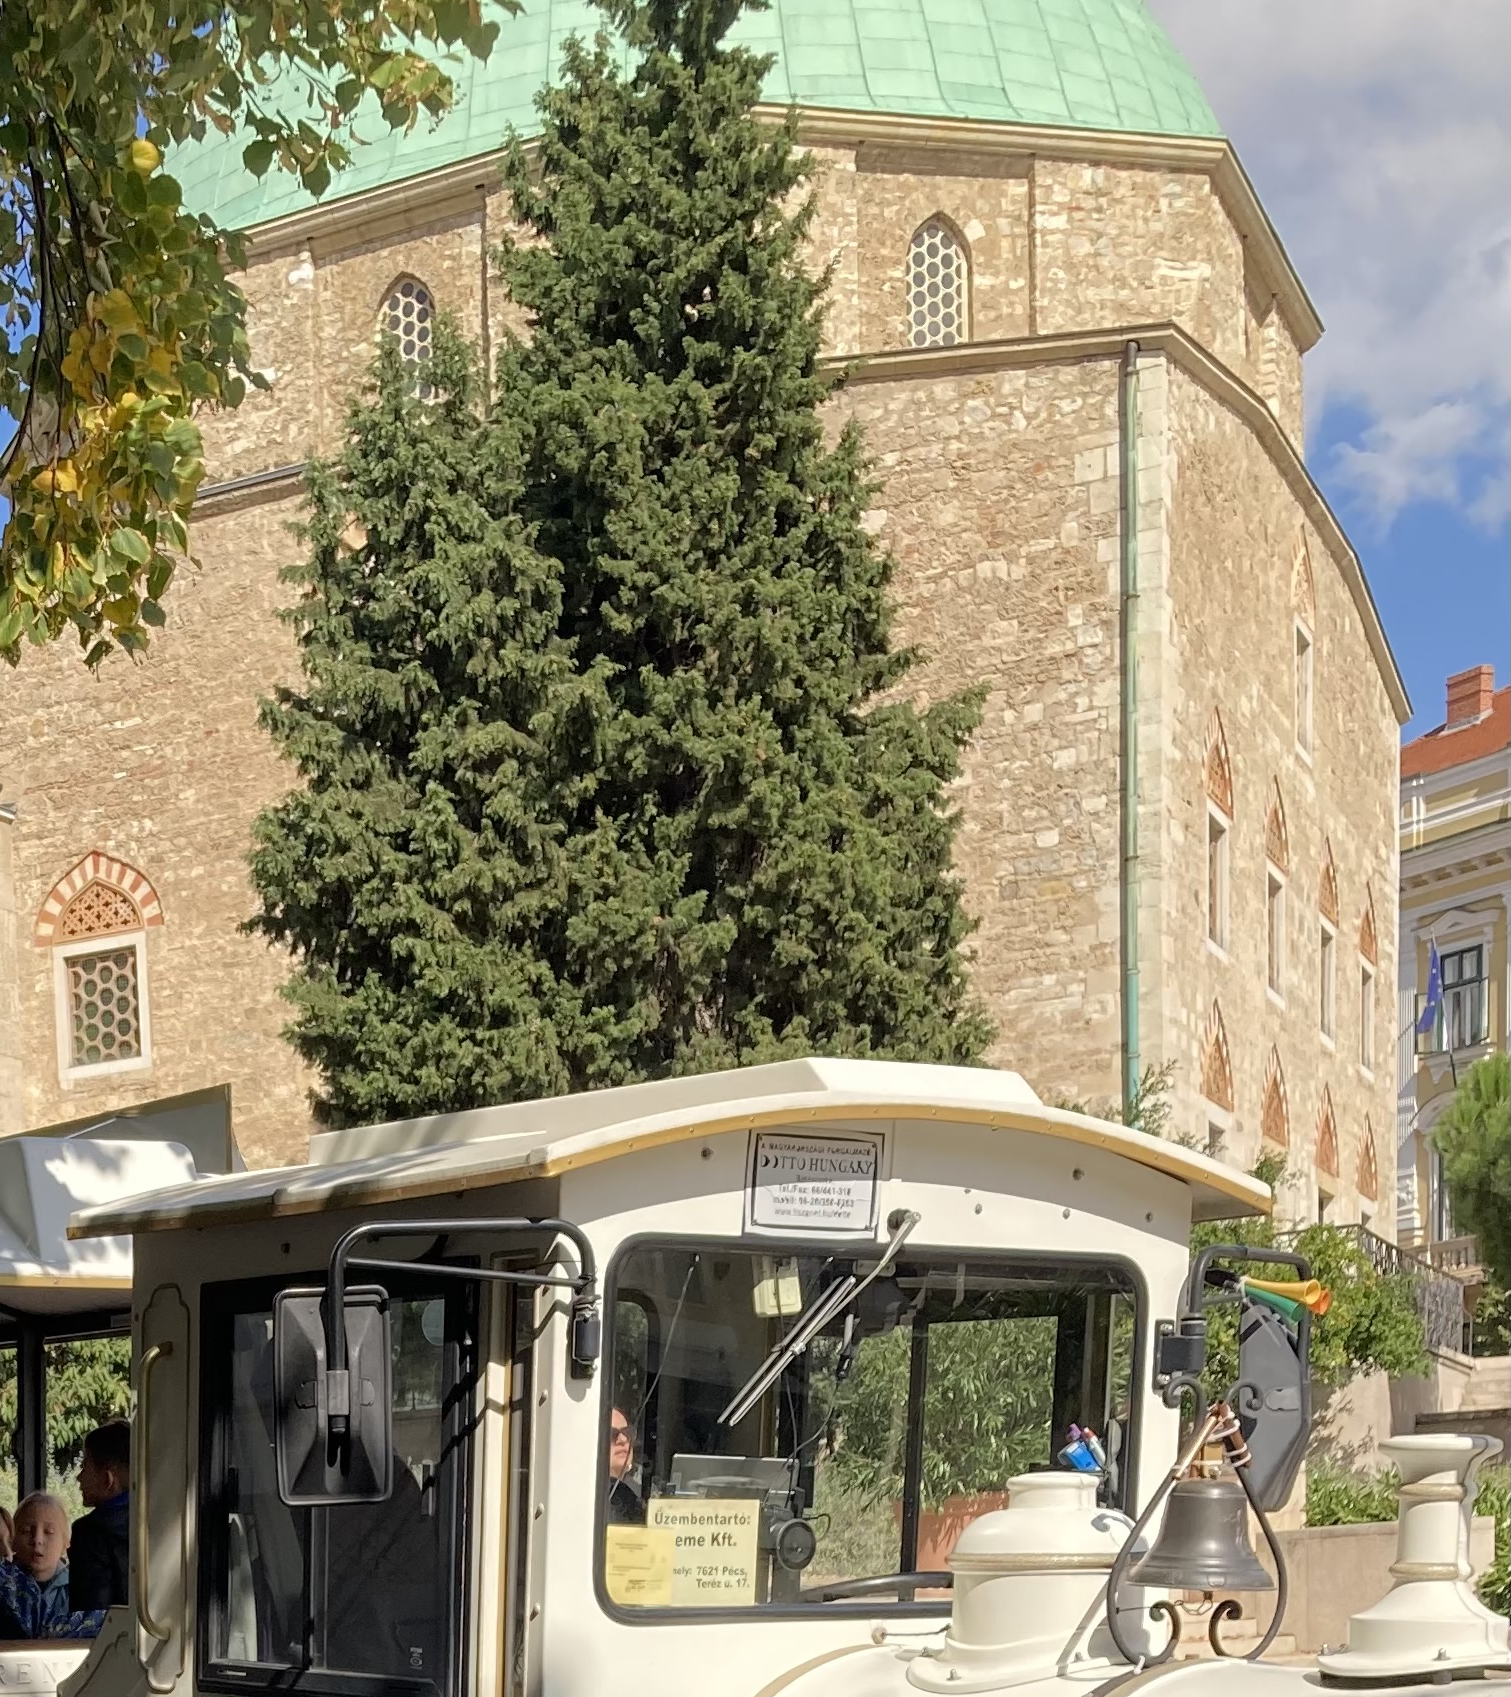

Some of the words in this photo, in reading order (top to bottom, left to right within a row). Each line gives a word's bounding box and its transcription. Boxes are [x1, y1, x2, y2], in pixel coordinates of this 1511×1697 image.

[809, 1158, 874, 1175] HUNGARY
[675, 1536, 705, 1547] eme
[711, 1532, 737, 1547] Kft.
[696, 1566, 719, 1576] 7621
[722, 1565, 748, 1578] Pécs,
[696, 1578, 722, 1588] Teréz
[736, 1578, 751, 1588] 17.
